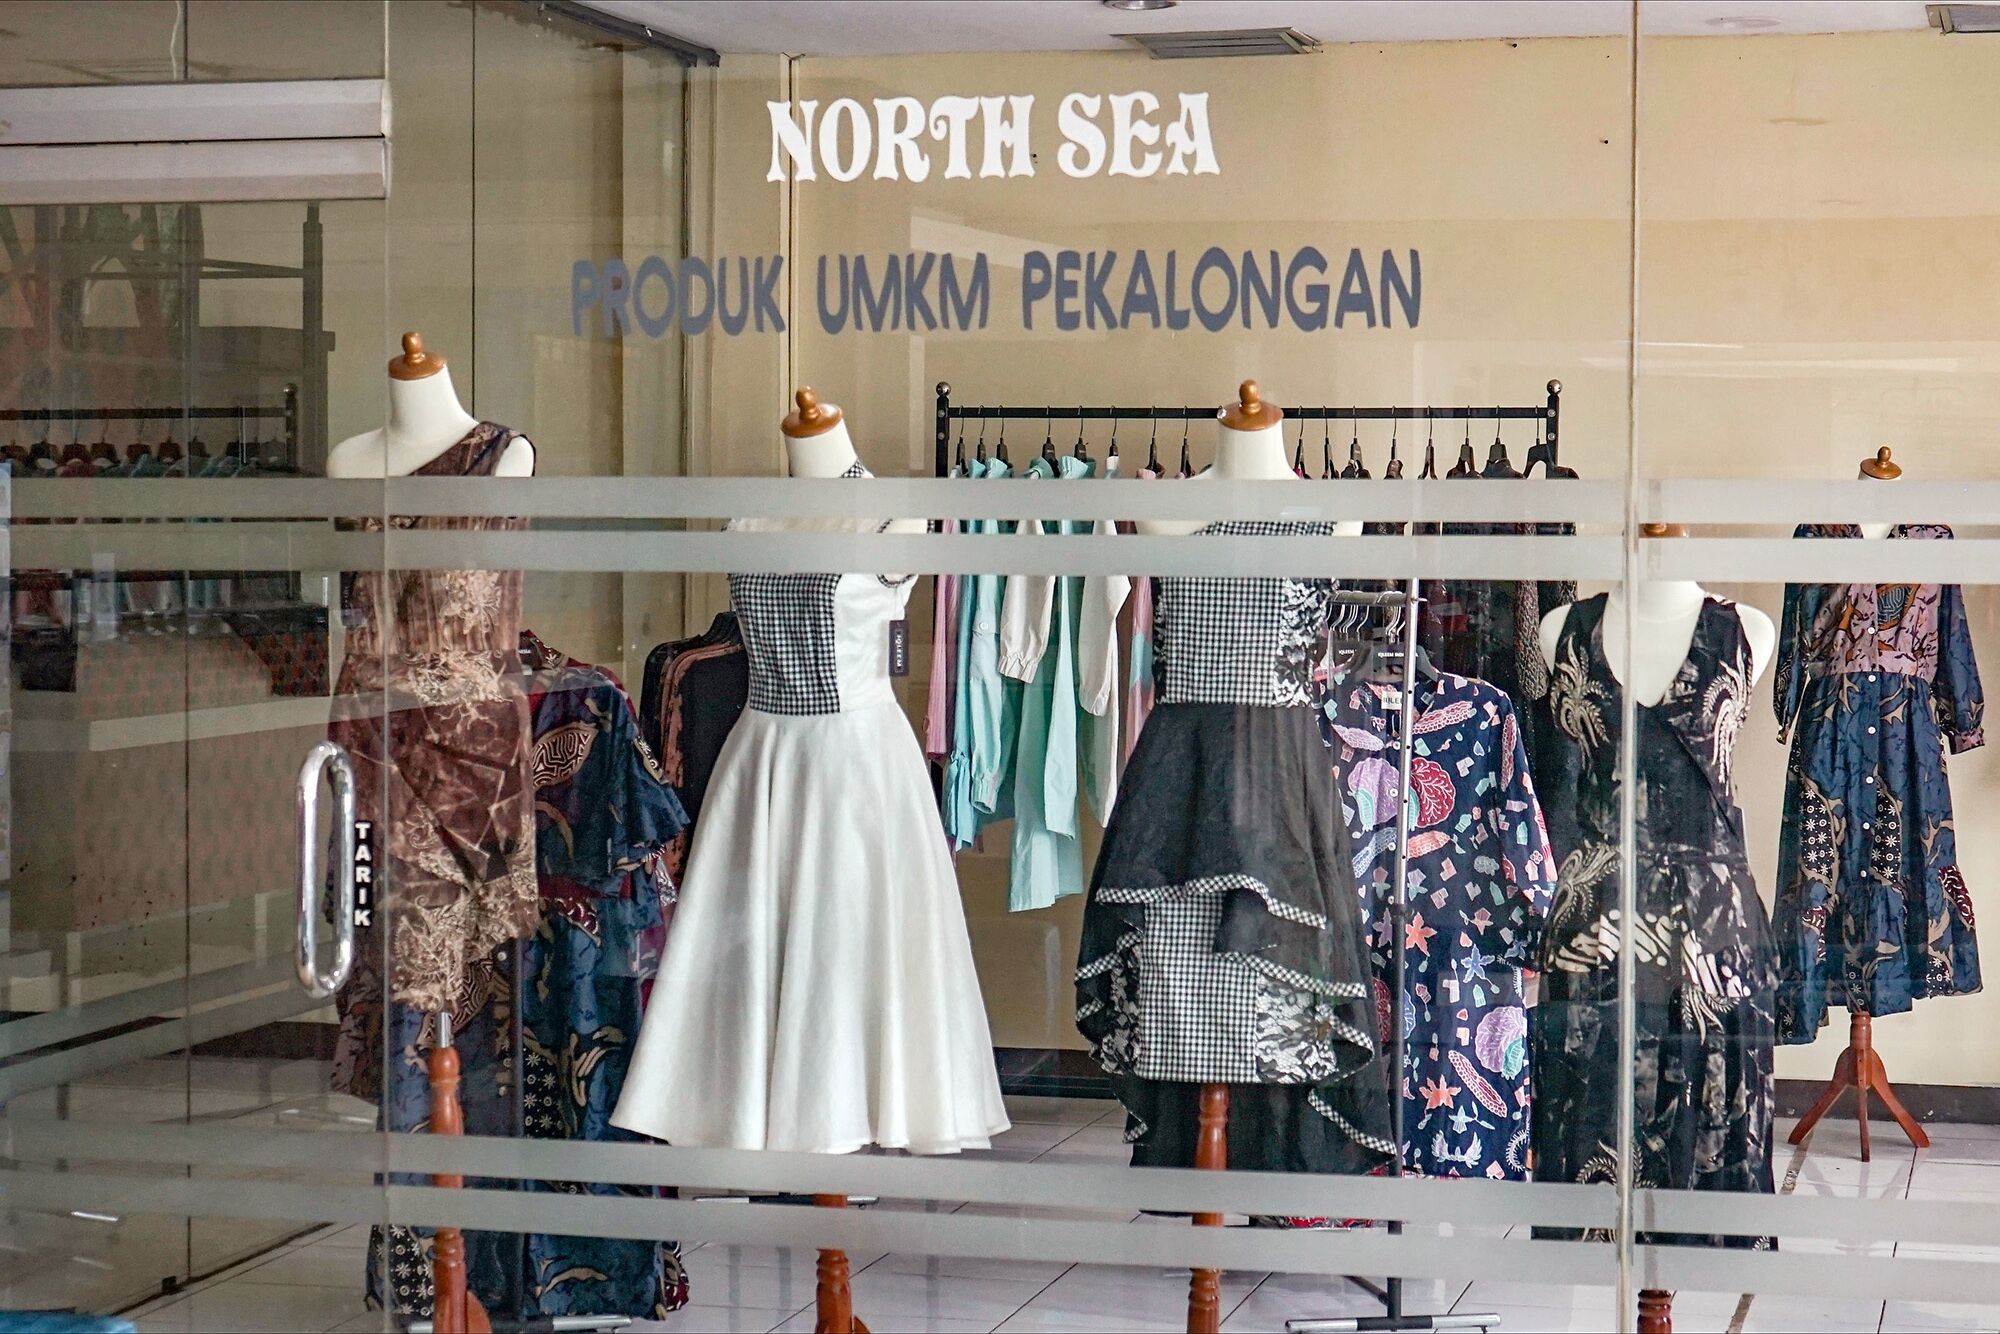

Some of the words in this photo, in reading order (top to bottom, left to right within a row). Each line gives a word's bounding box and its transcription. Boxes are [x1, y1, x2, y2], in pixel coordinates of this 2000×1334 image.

[765, 94, 1036, 183] NORTH
[1057, 90, 1221, 178] SEA
[571, 254, 786, 338] PRODUK
[817, 252, 990, 335] UMKM
[1022, 245, 1422, 333] PEKALONGAN
[354, 822, 372, 927] TARIK
